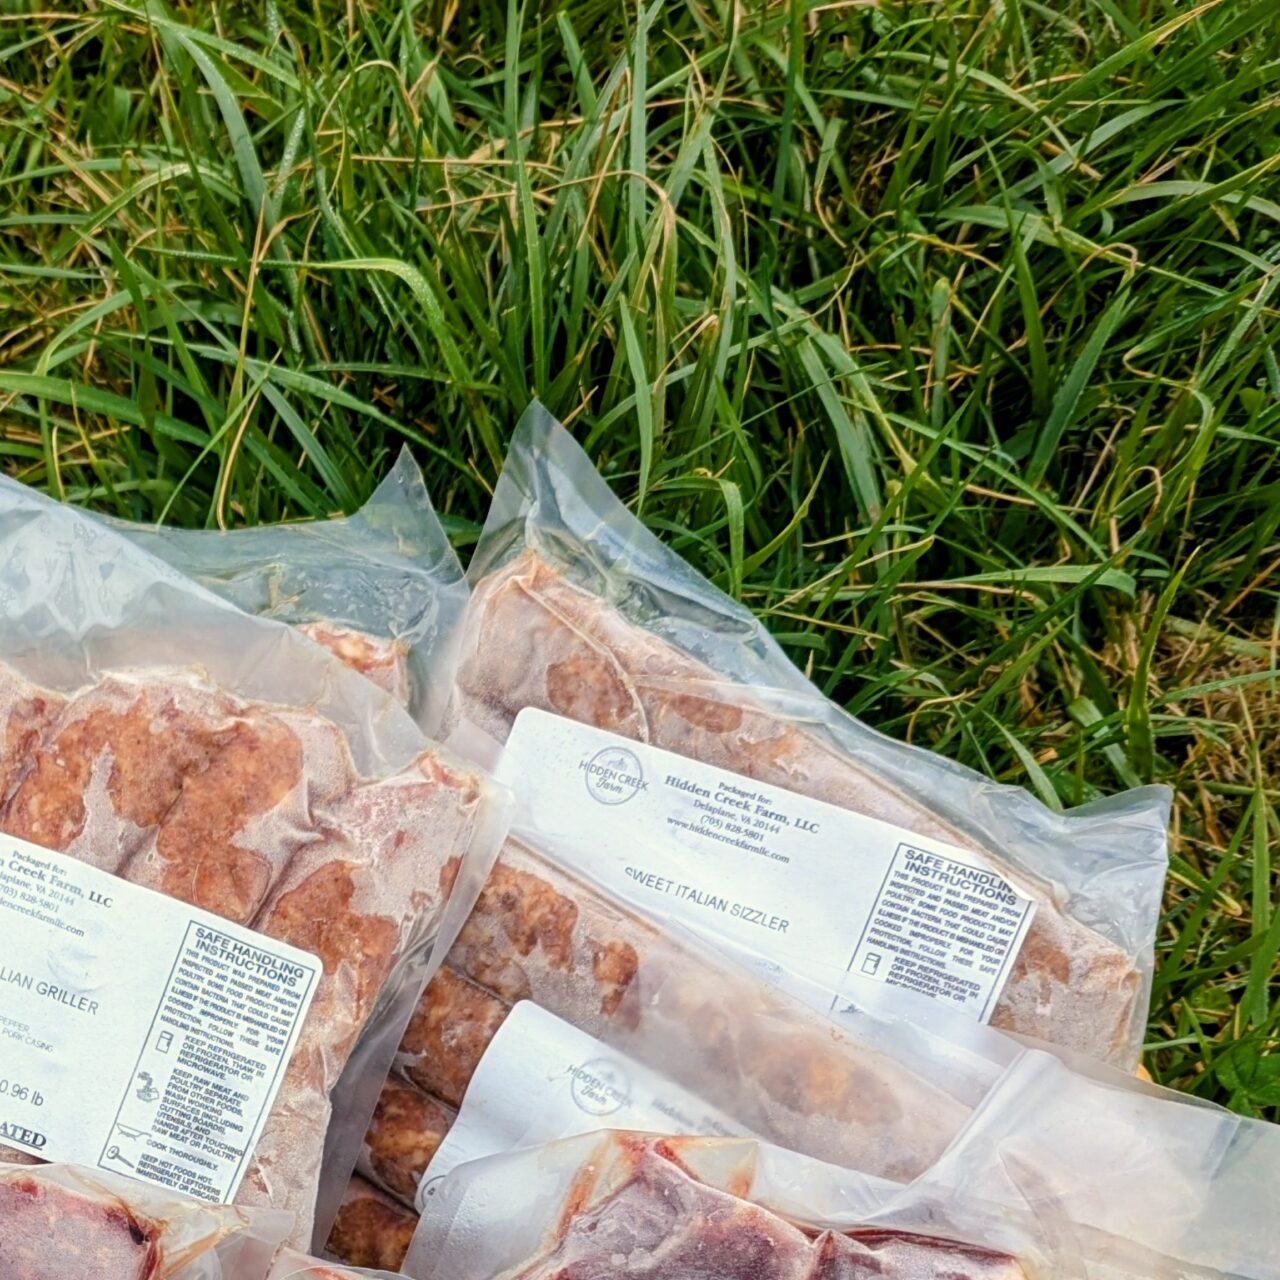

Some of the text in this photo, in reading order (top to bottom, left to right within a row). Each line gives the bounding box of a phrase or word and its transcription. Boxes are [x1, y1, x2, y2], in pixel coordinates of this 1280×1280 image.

[578, 759, 648, 791] HIDDEN CREEK
[595, 777, 624, 795] Farm
[664, 774, 819, 834] Hidden Creek Farm, LLC
[717, 781, 773, 806] Packaged for:
[692, 798, 780, 835] Delaplane, VA 20144
[723, 821, 764, 842] 828-5801
[666, 814, 790, 864] www.hiddencreekfarmllc.com
[11, 850, 68, 877] Packaged for:
[904, 848, 1015, 894] SAFE HANDLIN
[6, 859, 47, 883] Creek
[47, 875, 86, 898] Farm,
[87, 890, 114, 908] LLC
[33, 883, 47, 896] VA
[47, 888, 75, 907] 20144
[621, 865, 789, 934] SWEET ITALIAN SIZZLER
[904, 860, 1017, 906] INSTRUCTIONS
[194, 926, 305, 979] SAFE HANDLING
[194, 938, 297, 988] INSTRUCTIONS
[34, 980, 99, 1015] GRILLER
[178, 1048, 240, 1077] REFRIGERATOR
[183, 1034, 267, 1071] KEEP REFRIGERATED
[565, 1064, 605, 1092] HIDDEN
[30, 1090, 45, 1107] lb
